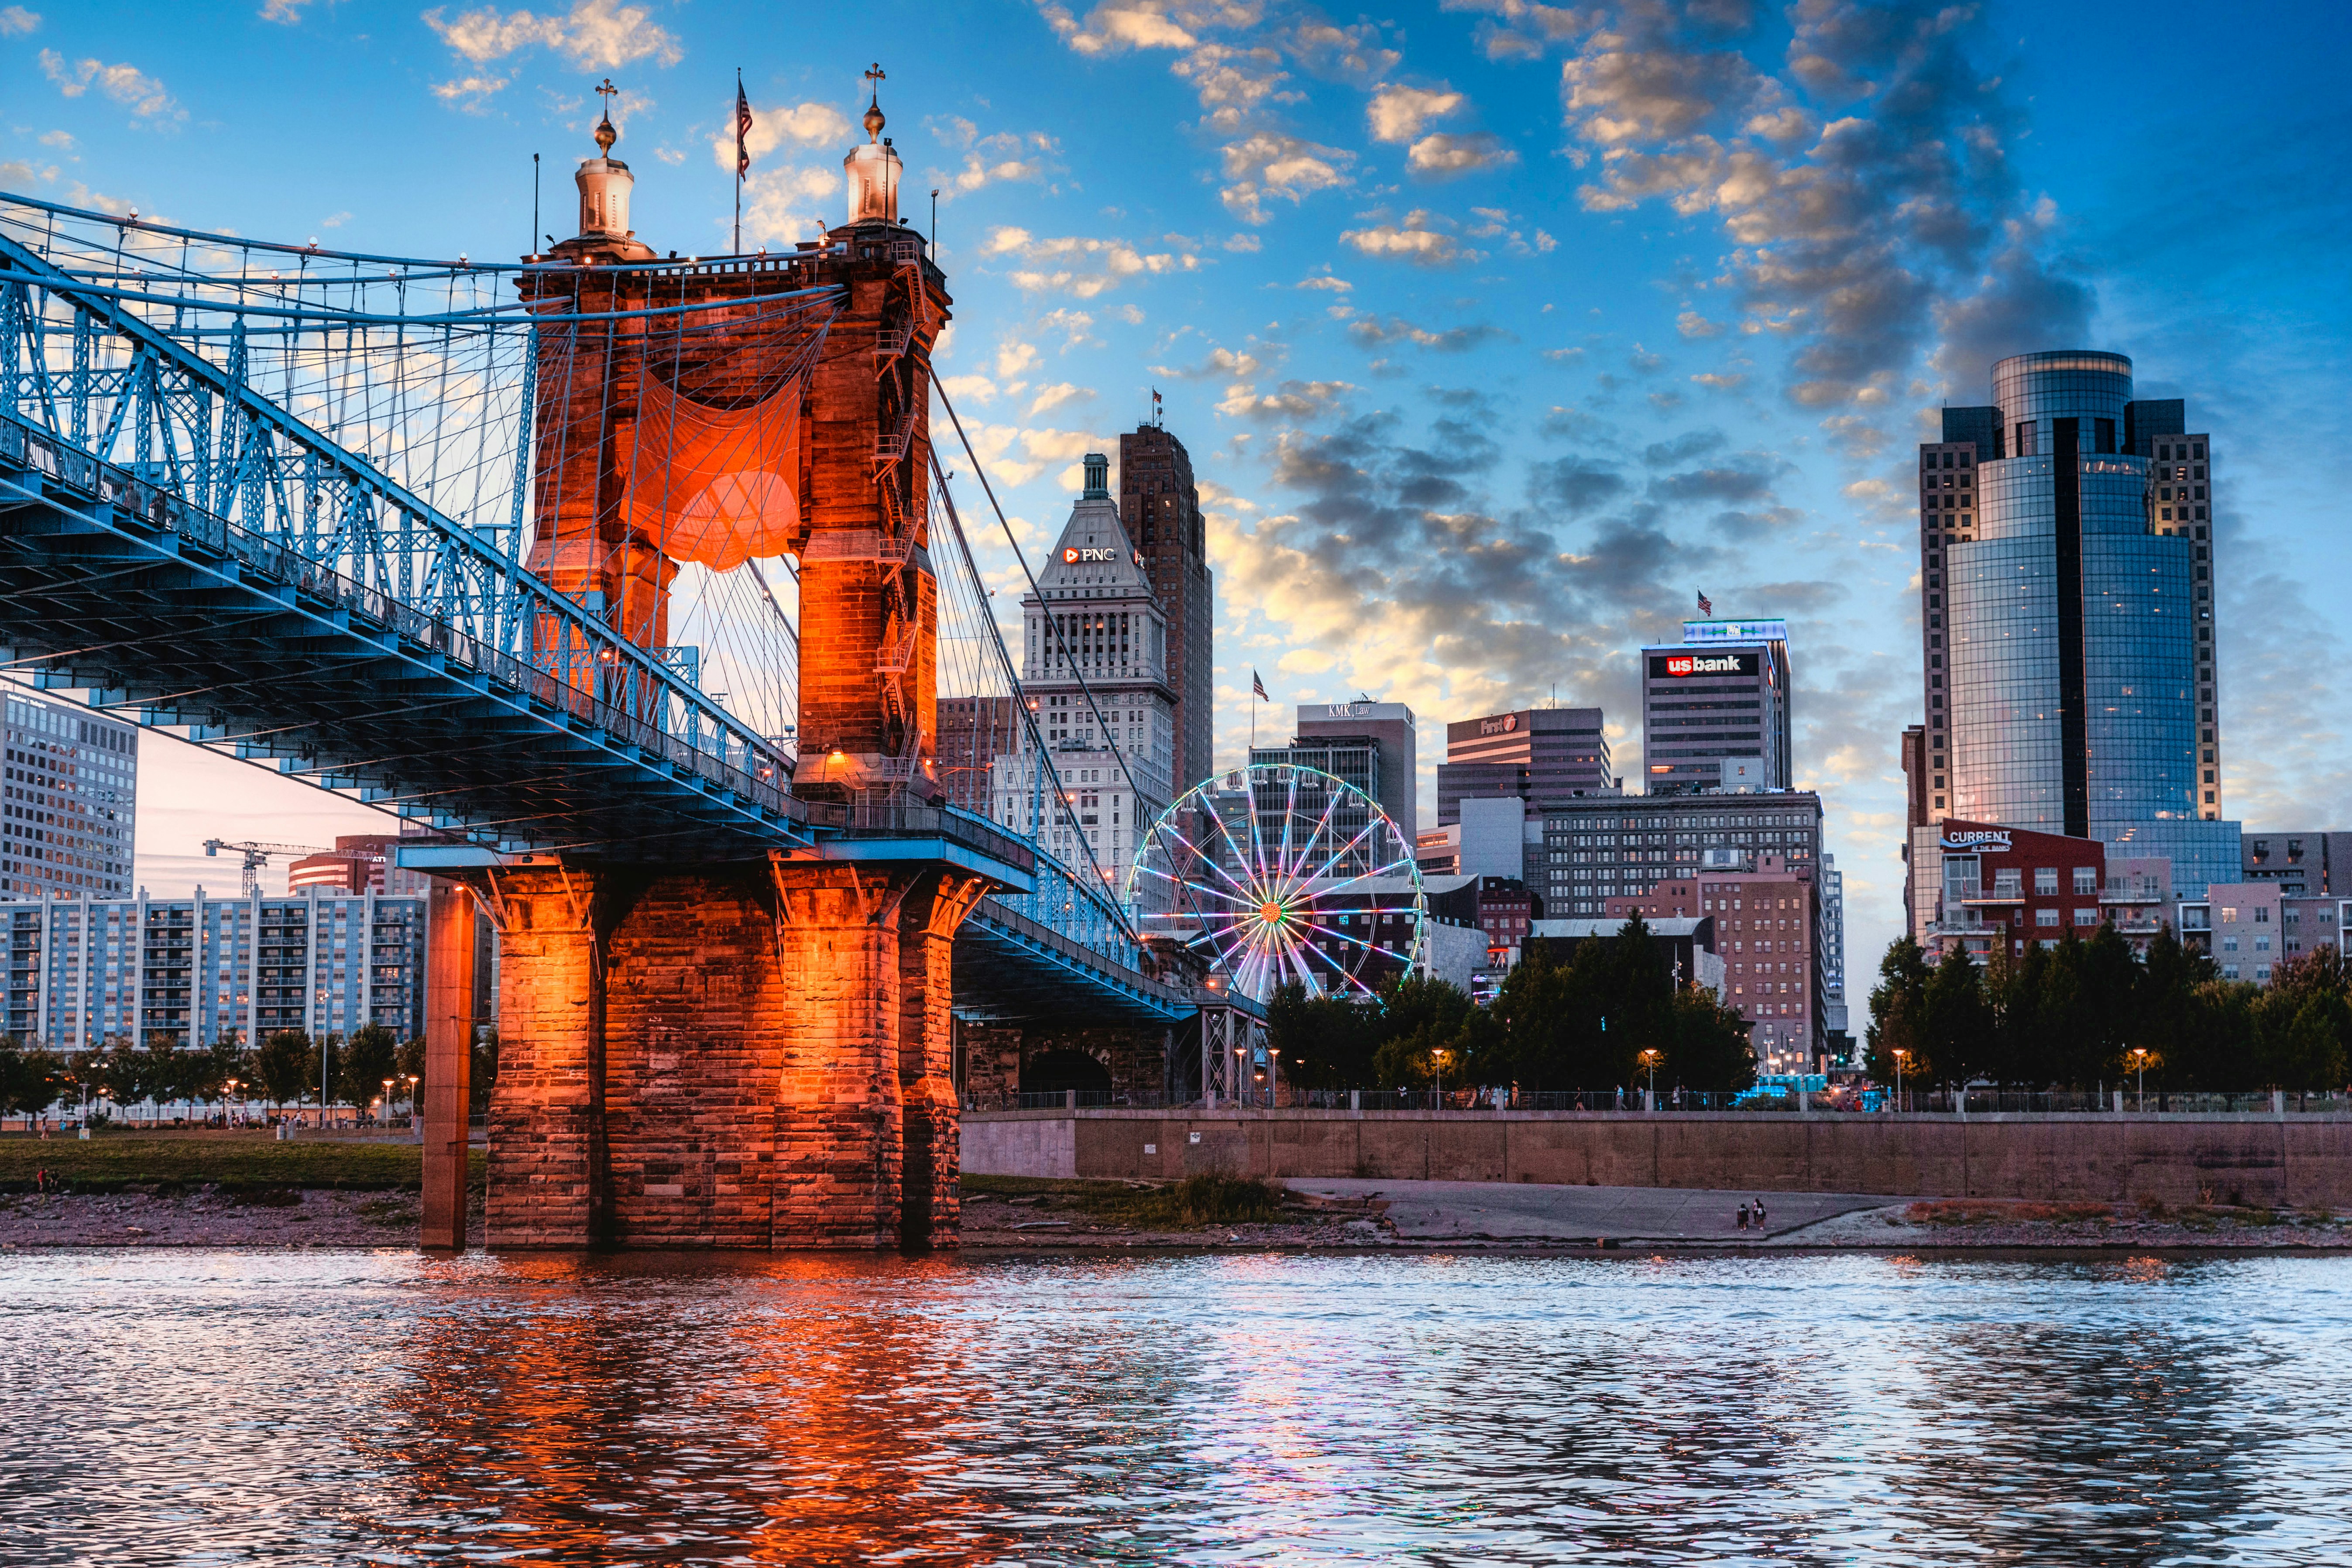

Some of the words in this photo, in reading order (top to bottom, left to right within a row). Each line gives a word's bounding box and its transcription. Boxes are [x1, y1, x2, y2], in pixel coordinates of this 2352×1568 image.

[1082, 548, 1114, 561] PNC
[1329, 704, 1351, 717] KMK
[1355, 704, 1370, 715] Law
[1481, 719, 1504, 734] First
[1950, 831, 2011, 842] CURRENT
